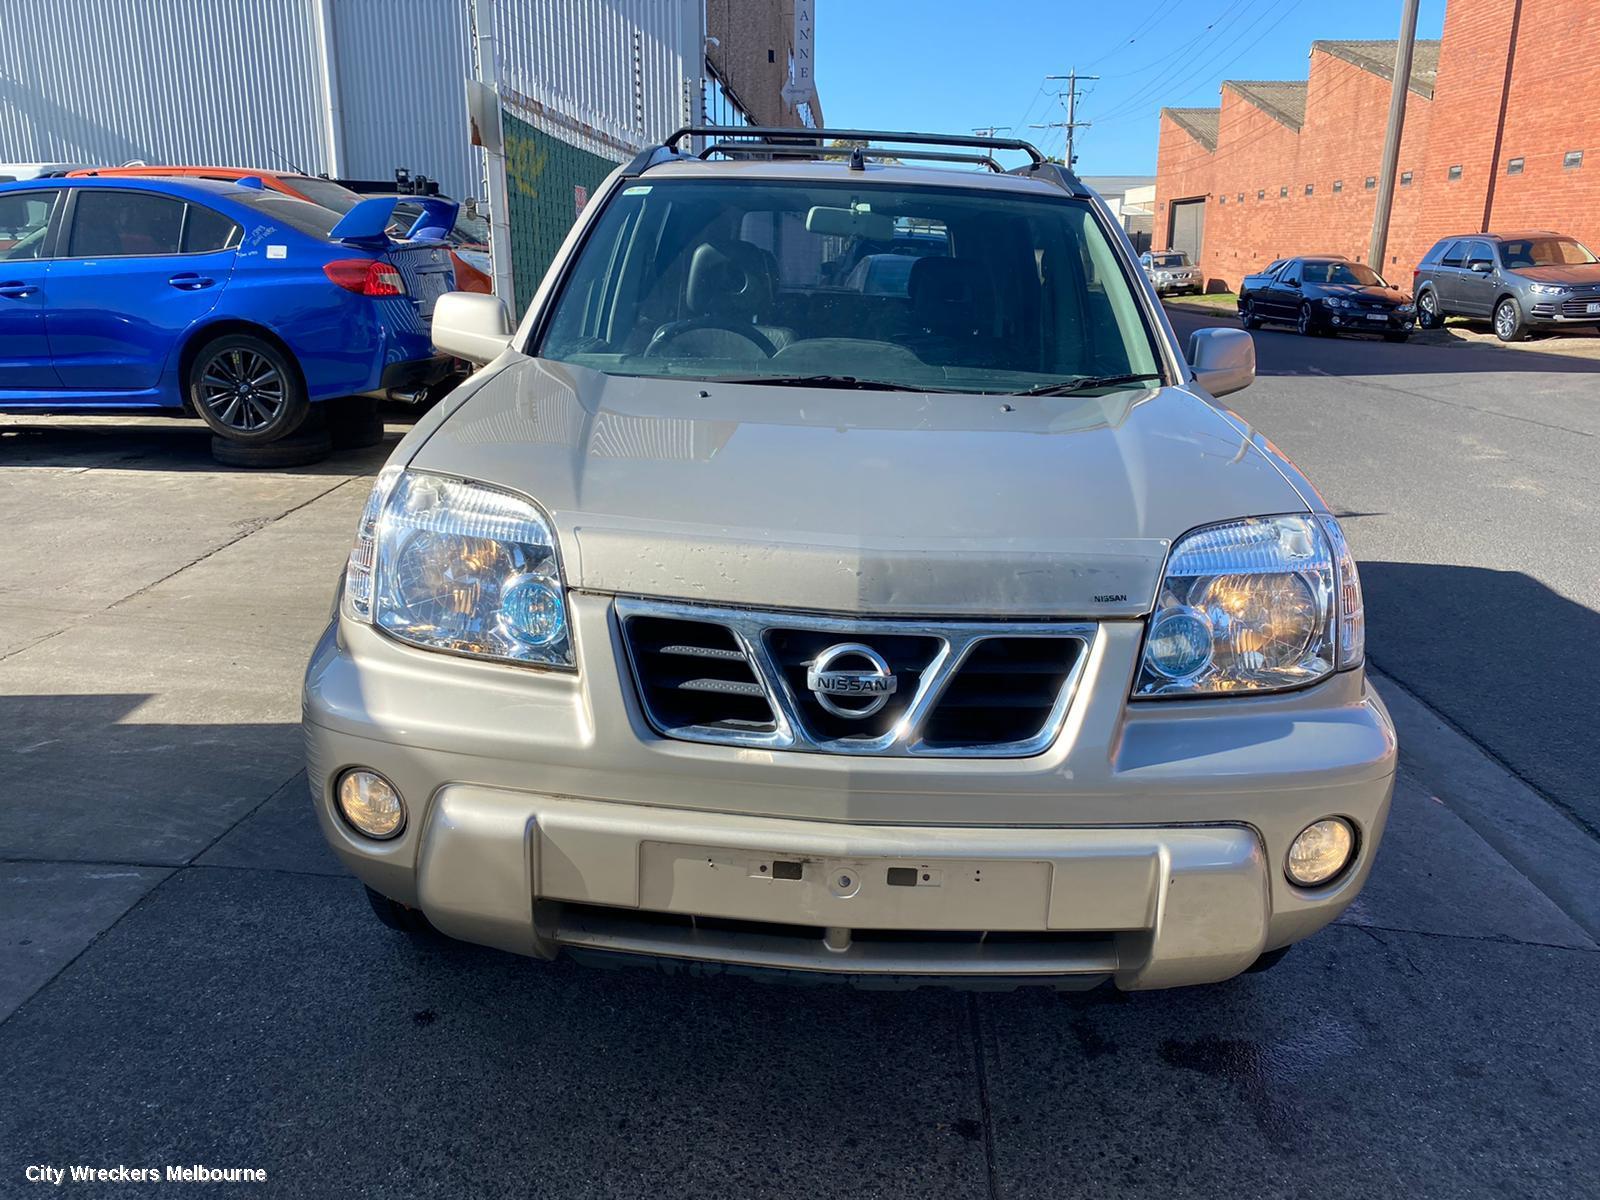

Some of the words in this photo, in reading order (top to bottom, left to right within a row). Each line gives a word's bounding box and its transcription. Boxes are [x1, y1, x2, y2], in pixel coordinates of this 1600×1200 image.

[799, 0, 809, 78] ANNE
[1094, 594, 1127, 602] NISSAN
[817, 677, 888, 691] NISSAN
